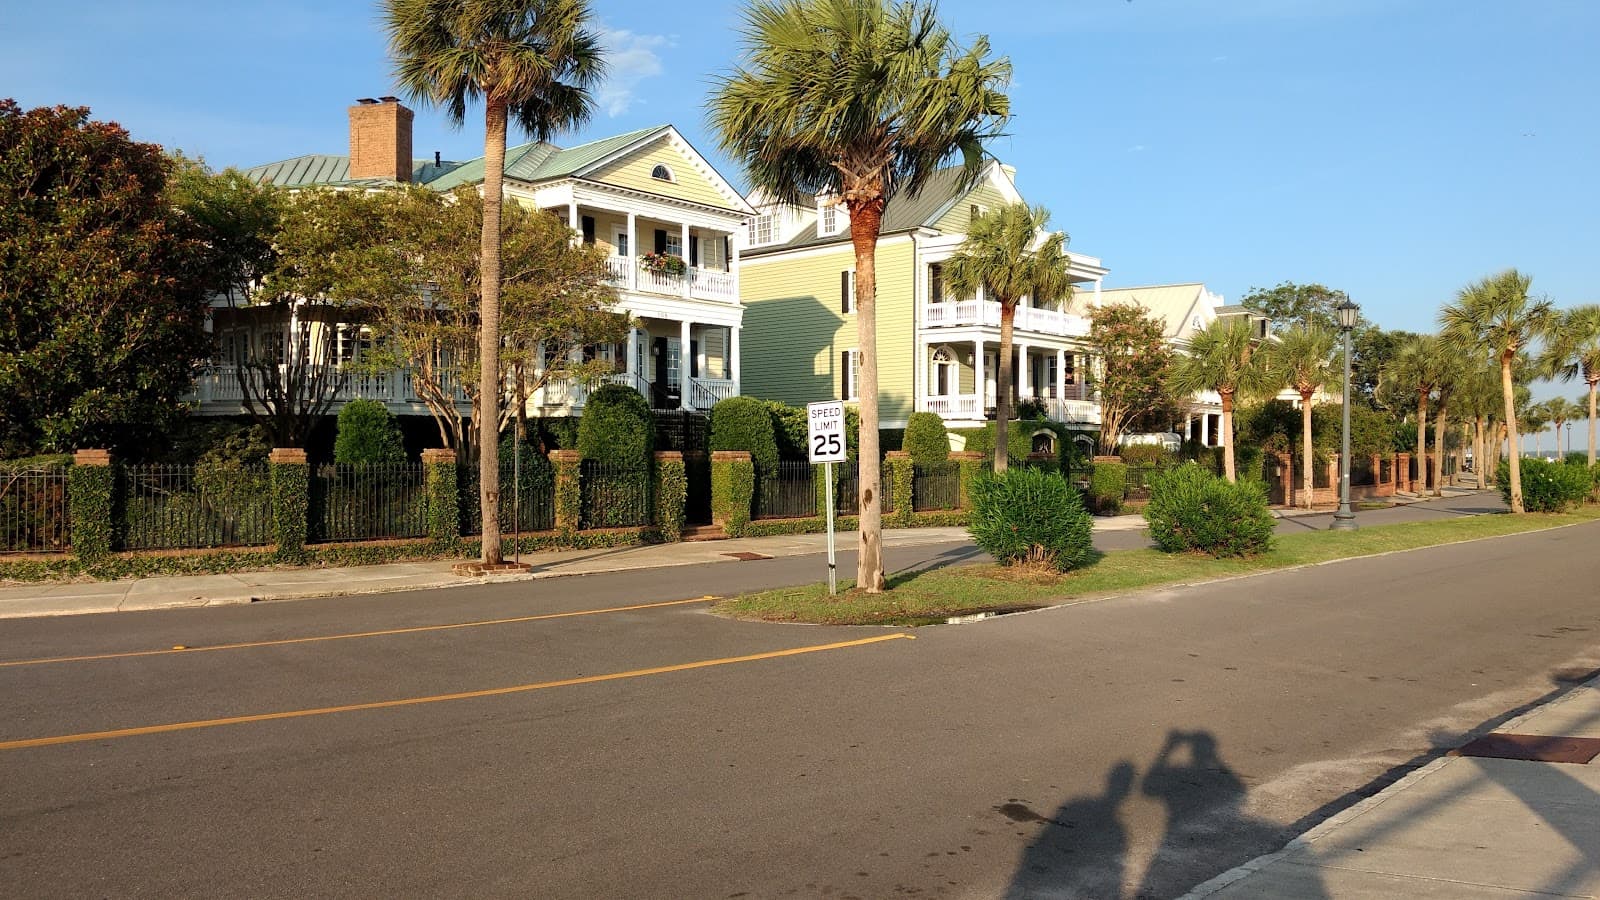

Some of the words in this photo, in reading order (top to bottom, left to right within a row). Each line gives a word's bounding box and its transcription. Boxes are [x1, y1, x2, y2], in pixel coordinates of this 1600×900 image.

[811, 407, 841, 419] SPEED
[814, 420, 838, 431] LIMIT
[814, 433, 841, 456] 25
